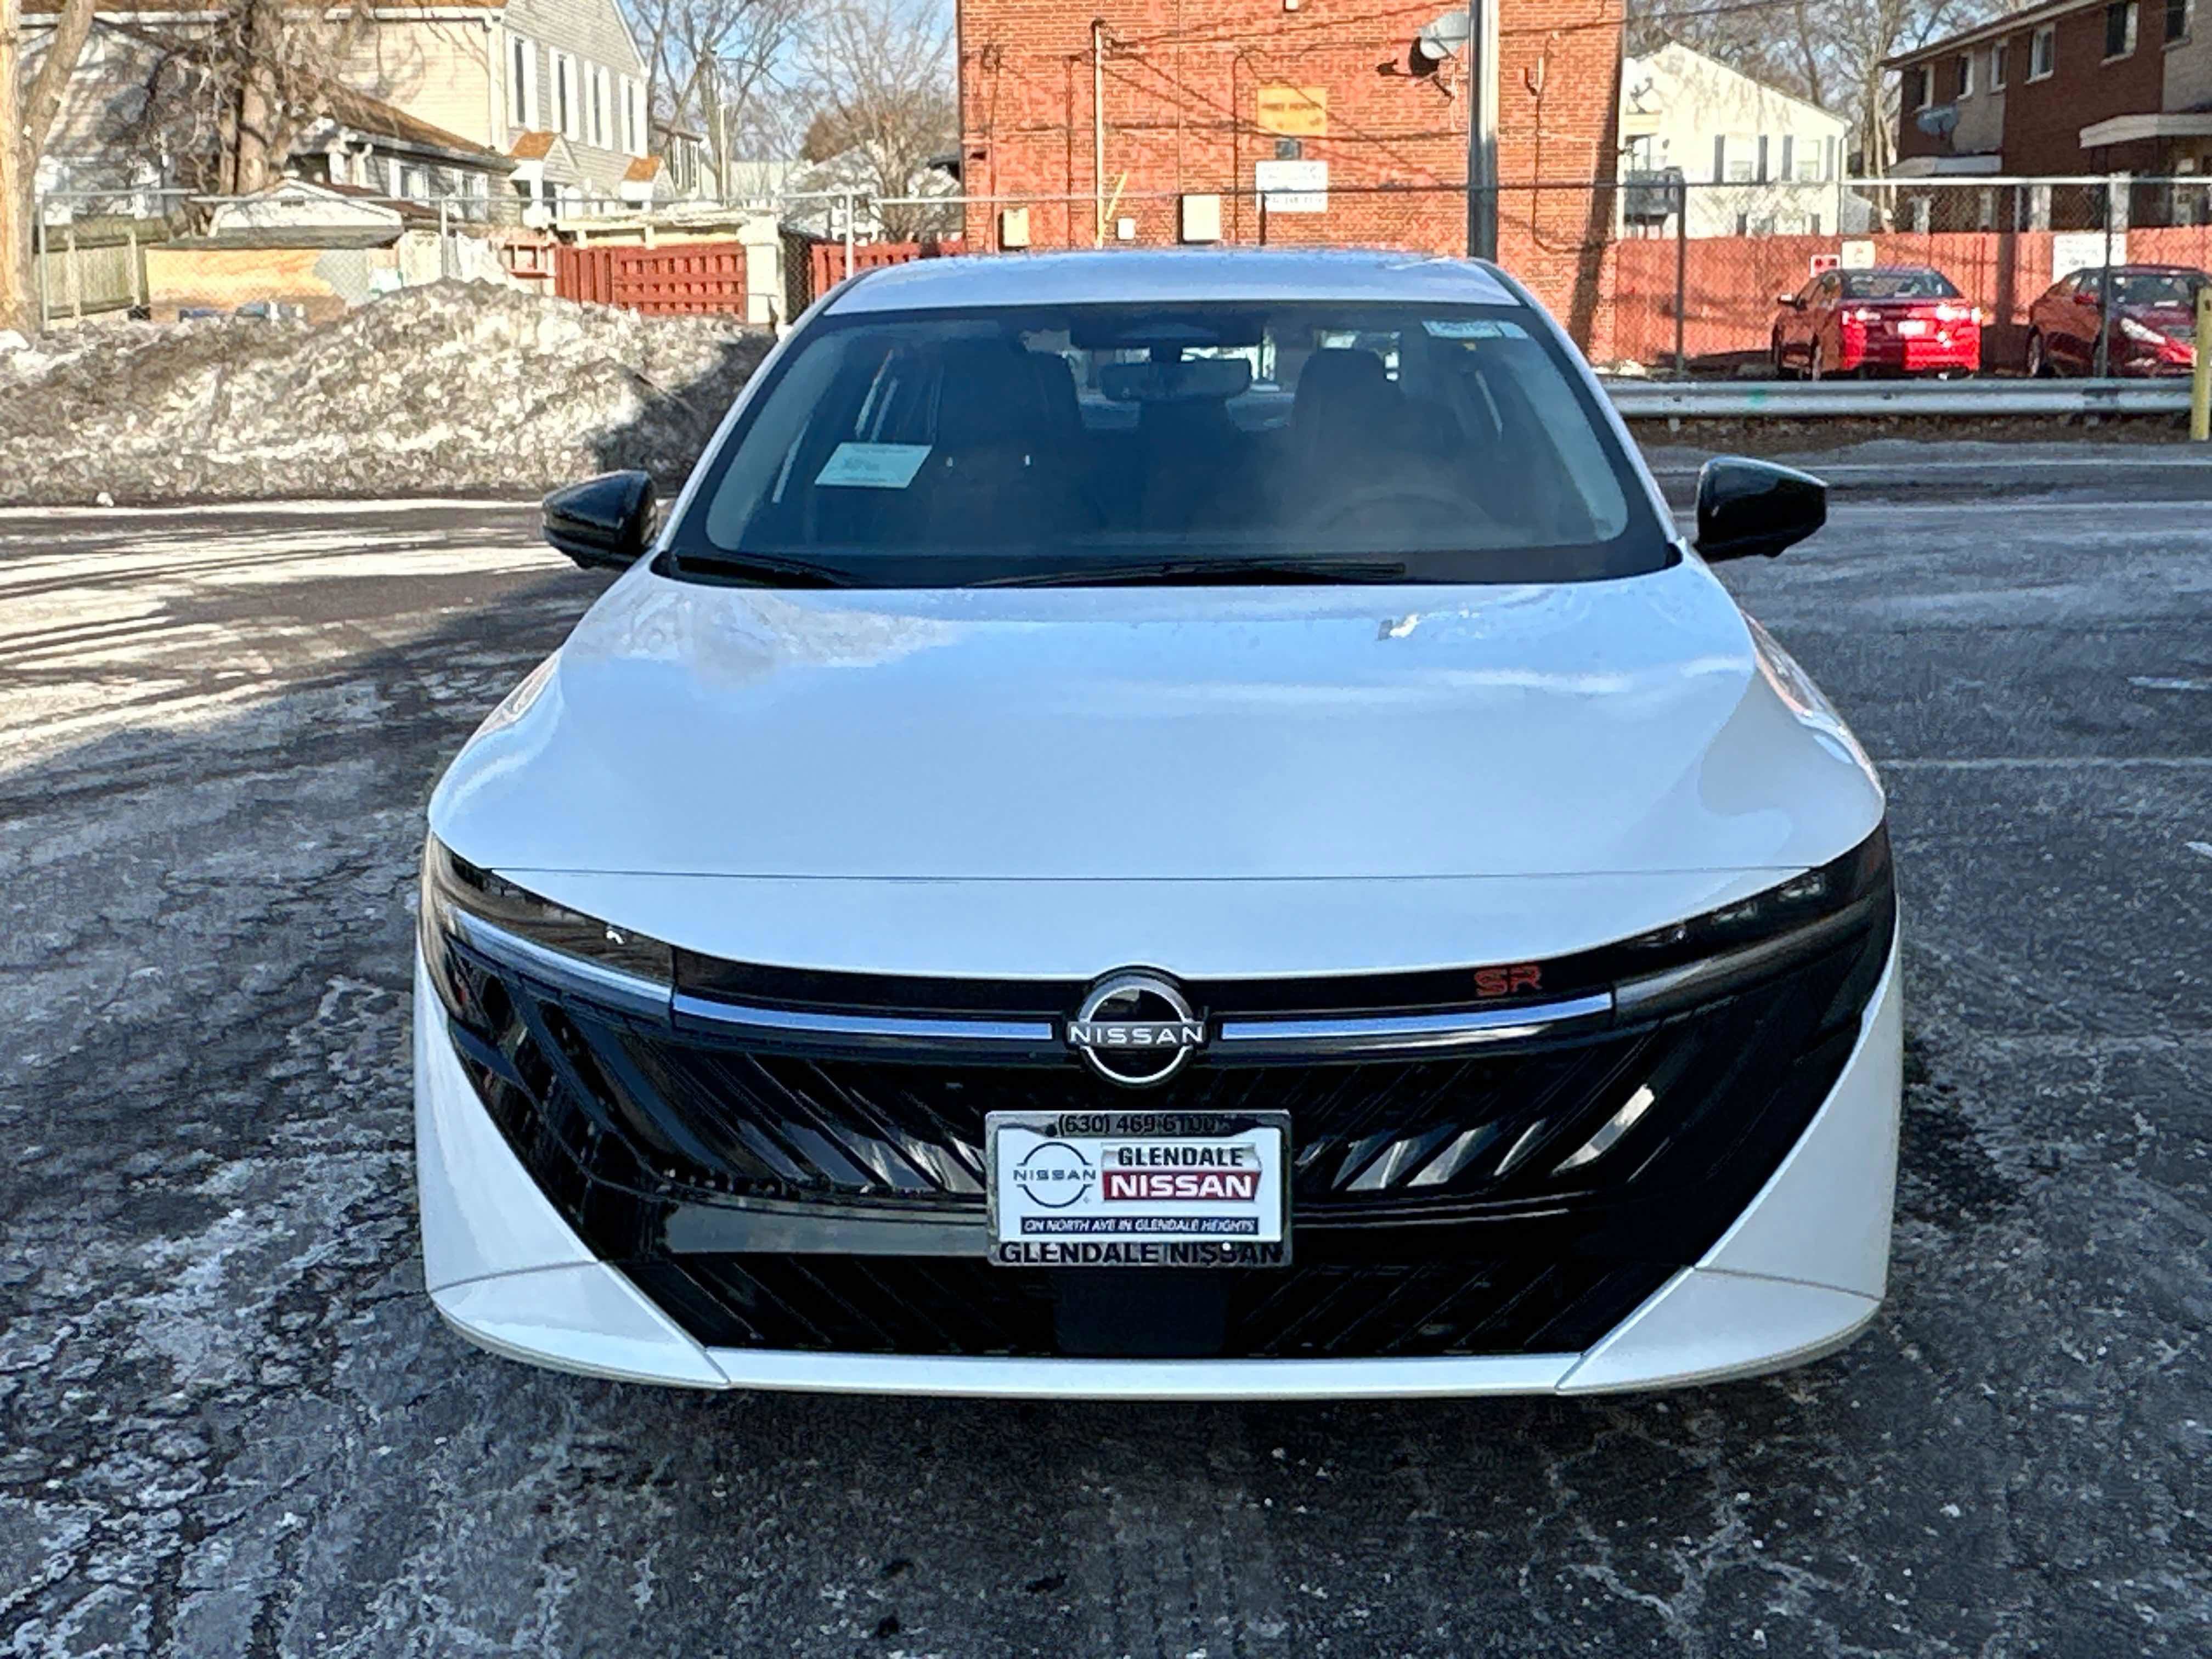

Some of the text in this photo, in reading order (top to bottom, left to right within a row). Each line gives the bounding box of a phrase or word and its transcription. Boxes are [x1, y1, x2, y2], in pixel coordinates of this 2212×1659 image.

[1474, 965, 1542, 996] SR
[1070, 1026, 1203, 1044] NISSAN
[1058, 1114, 1109, 1136] (630)
[1118, 1147, 1243, 1166] GLENDALE
[1013, 1170, 1096, 1181] NISSAN
[1110, 1175, 1252, 1197] NISSAN
[1024, 1219, 1255, 1231] ON NORTH AVE IN GLENDALE HEIGHTS
[999, 1242, 1284, 1263] GLENDALE NISSAN
